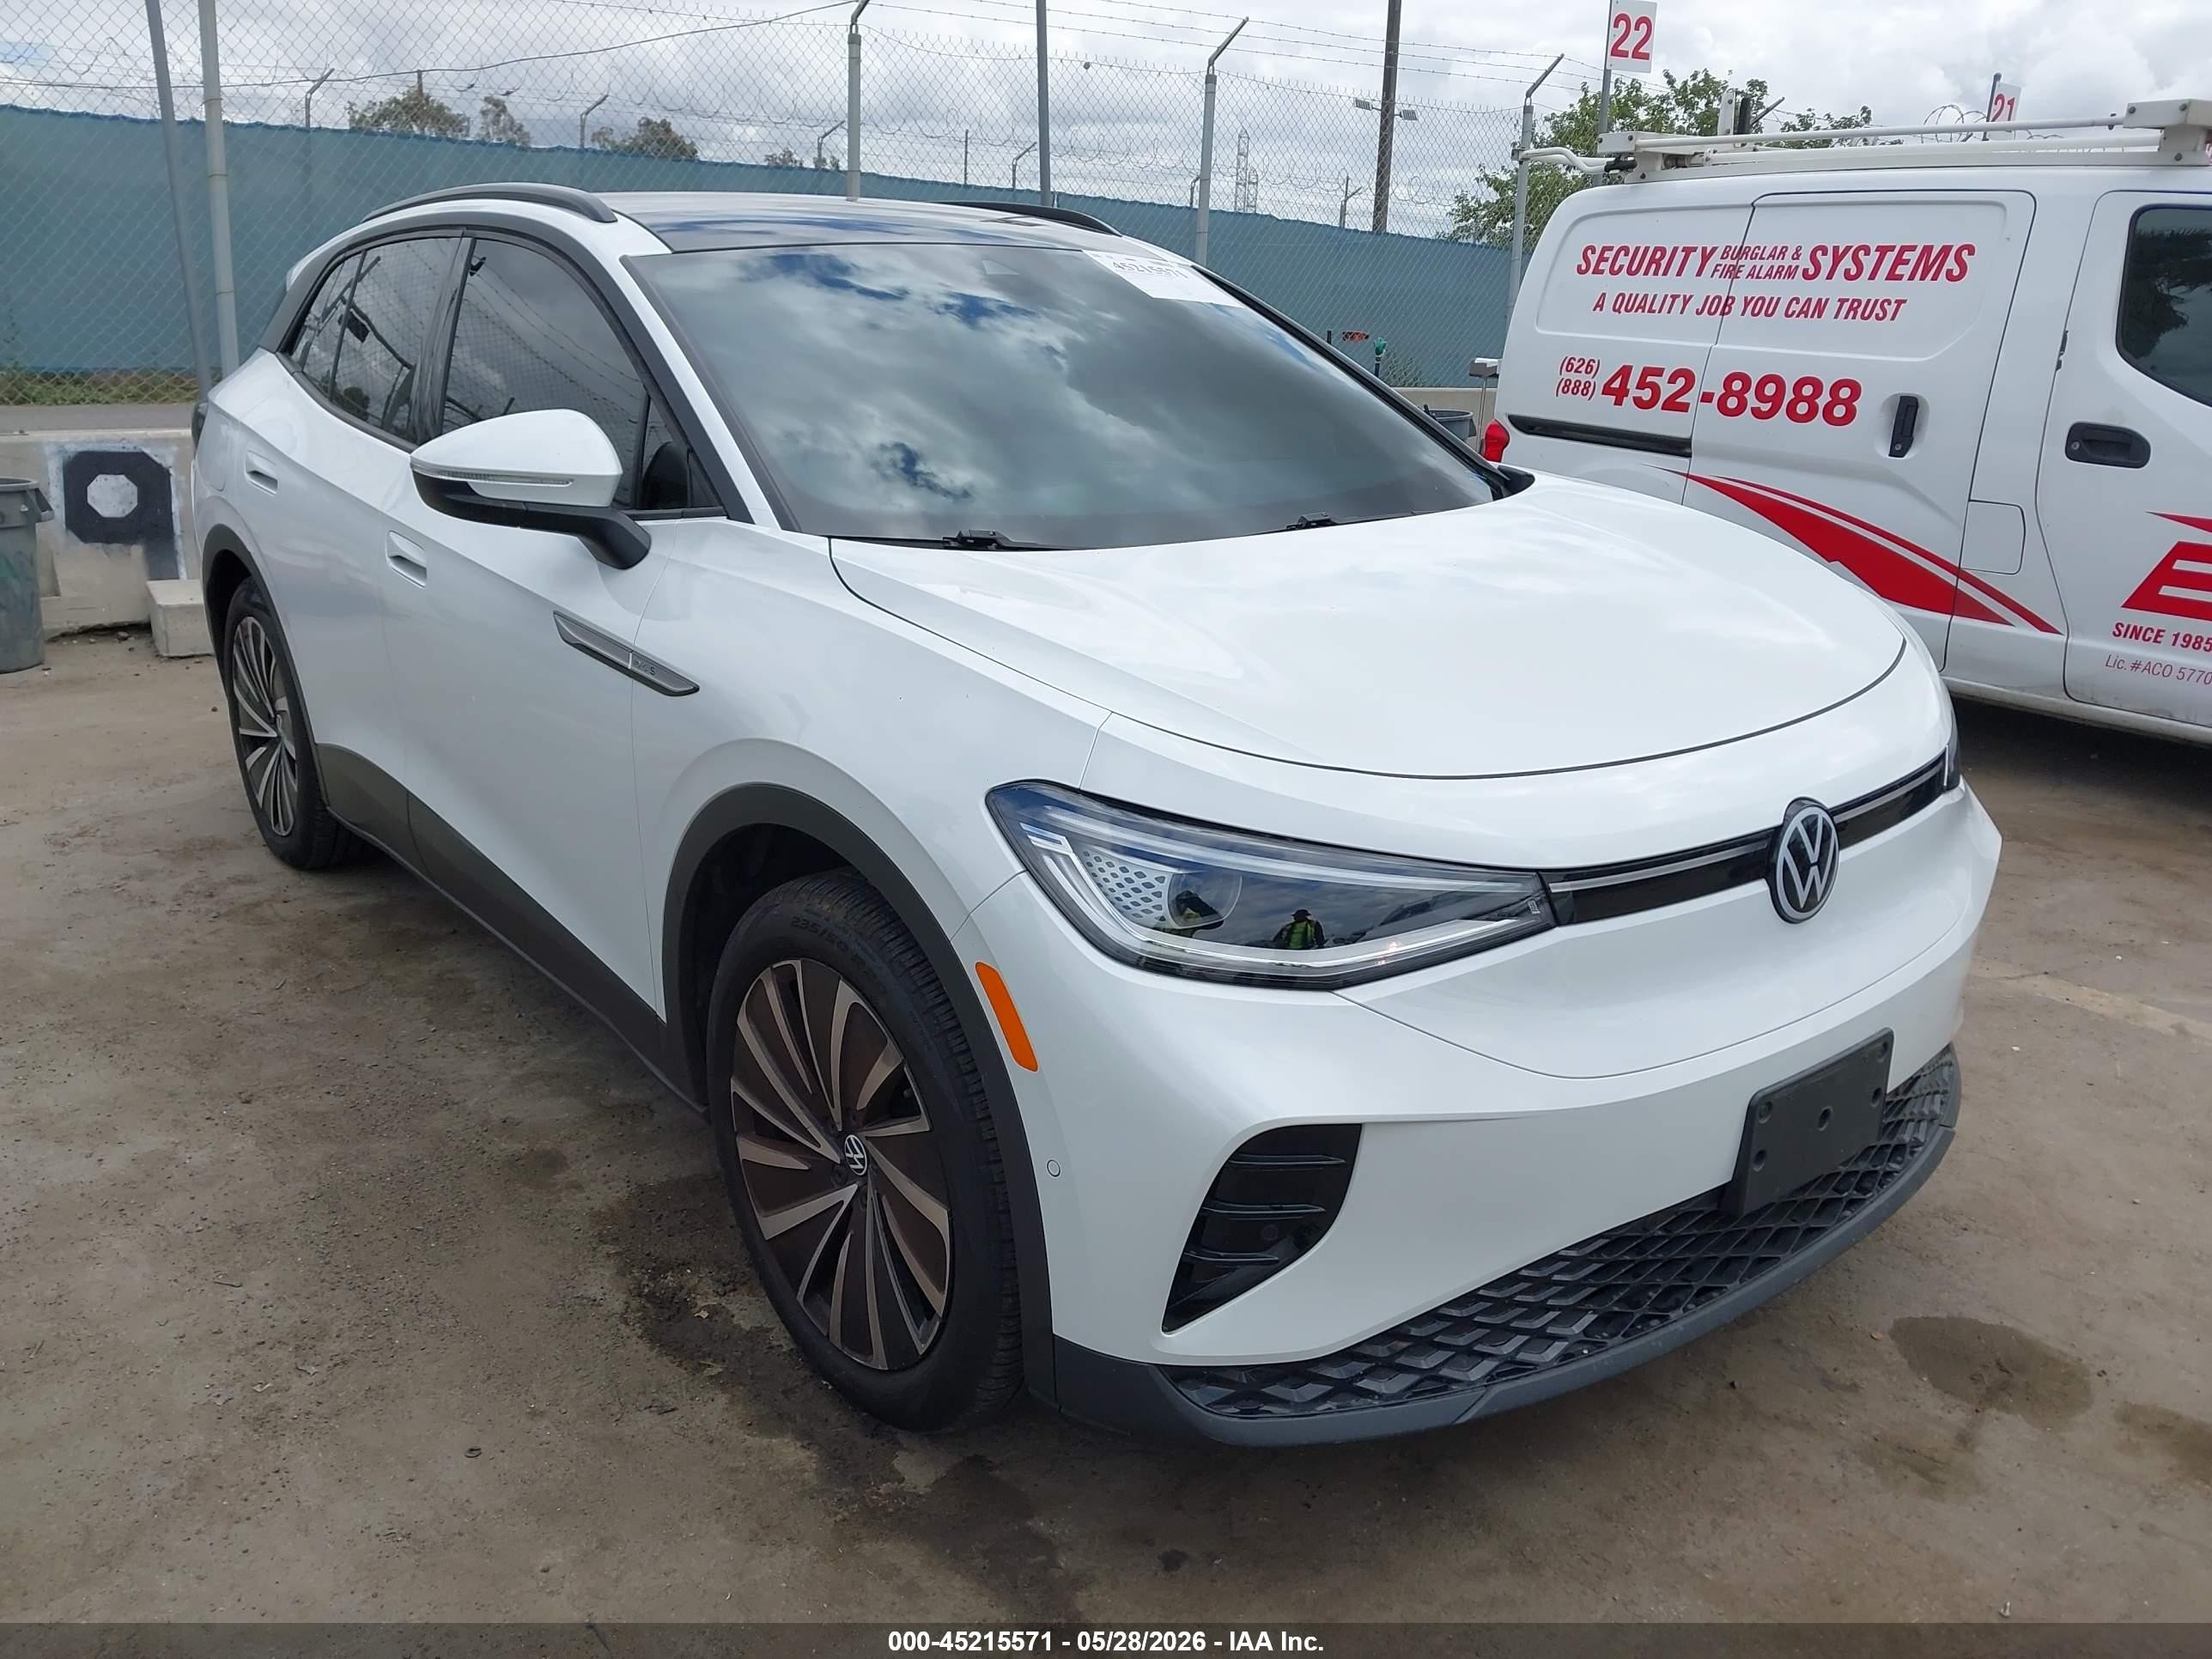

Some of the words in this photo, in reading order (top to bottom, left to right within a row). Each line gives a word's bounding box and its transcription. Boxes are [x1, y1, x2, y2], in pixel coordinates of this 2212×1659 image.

[1610, 12, 1653, 60] 22
[1990, 93, 2015, 123] 21
[1577, 245, 1718, 276] SECURITY
[1720, 246, 1789, 260] BURGLAR
[1791, 246, 1802, 260] &
[1802, 244, 1975, 282] SYSTEMS
[1711, 264, 1745, 279] FIRE
[1746, 264, 1800, 280] ALARM
[1593, 292, 1607, 312] A
[1613, 293, 1693, 314] QUALITY
[1696, 295, 1735, 316] JOB
[1741, 296, 1781, 318] YOU
[1784, 297, 1829, 319] CAN
[1833, 298, 1907, 321] TRUST
[1559, 356, 1601, 379] (626)
[1556, 378, 1596, 400] (888)
[1601, 365, 1862, 426] 452-8988
[2112, 623, 2166, 644] SINCE
[2172, 632, 2212, 653] 1985
[2106, 654, 2127, 671] Lic.
[2130, 659, 2173, 678] #ACO
